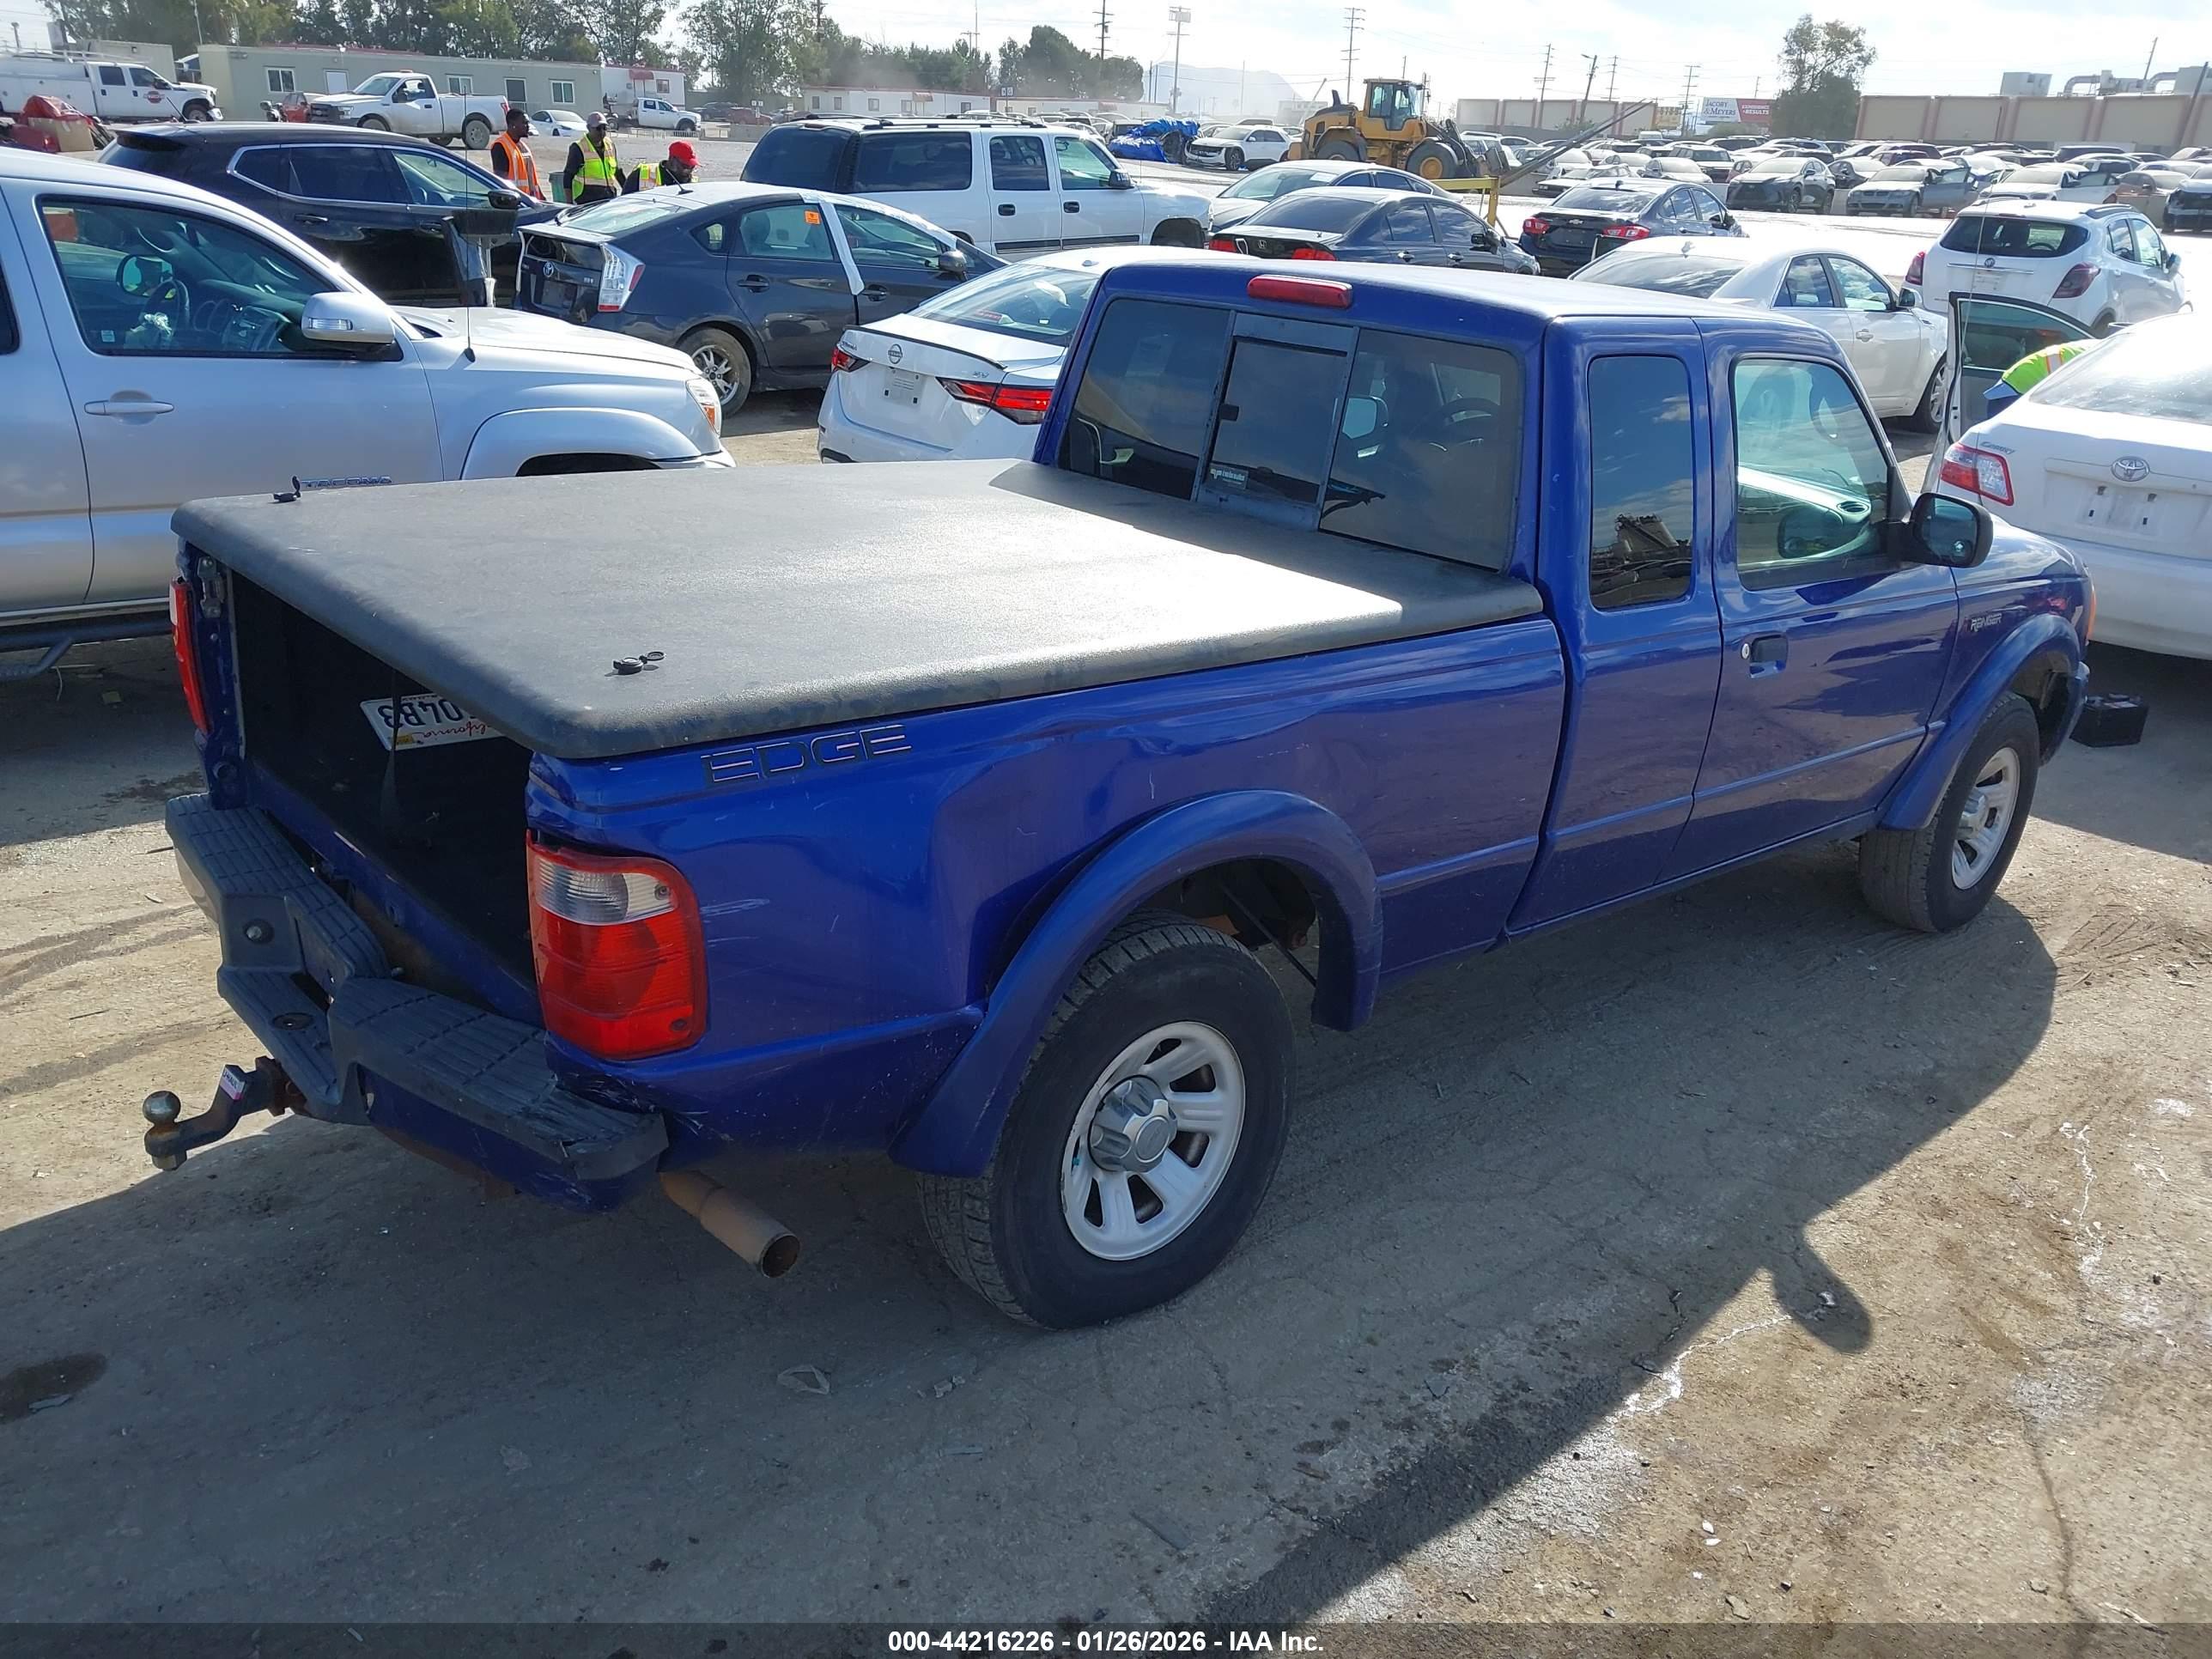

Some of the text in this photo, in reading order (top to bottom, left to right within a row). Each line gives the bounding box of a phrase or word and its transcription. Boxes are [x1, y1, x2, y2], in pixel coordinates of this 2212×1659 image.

[1705, 99, 1728, 107] JACOBY
[301, 477, 392, 488] TACOMA
[377, 699, 475, 730] 04B3
[701, 725, 912, 787] EDGE
